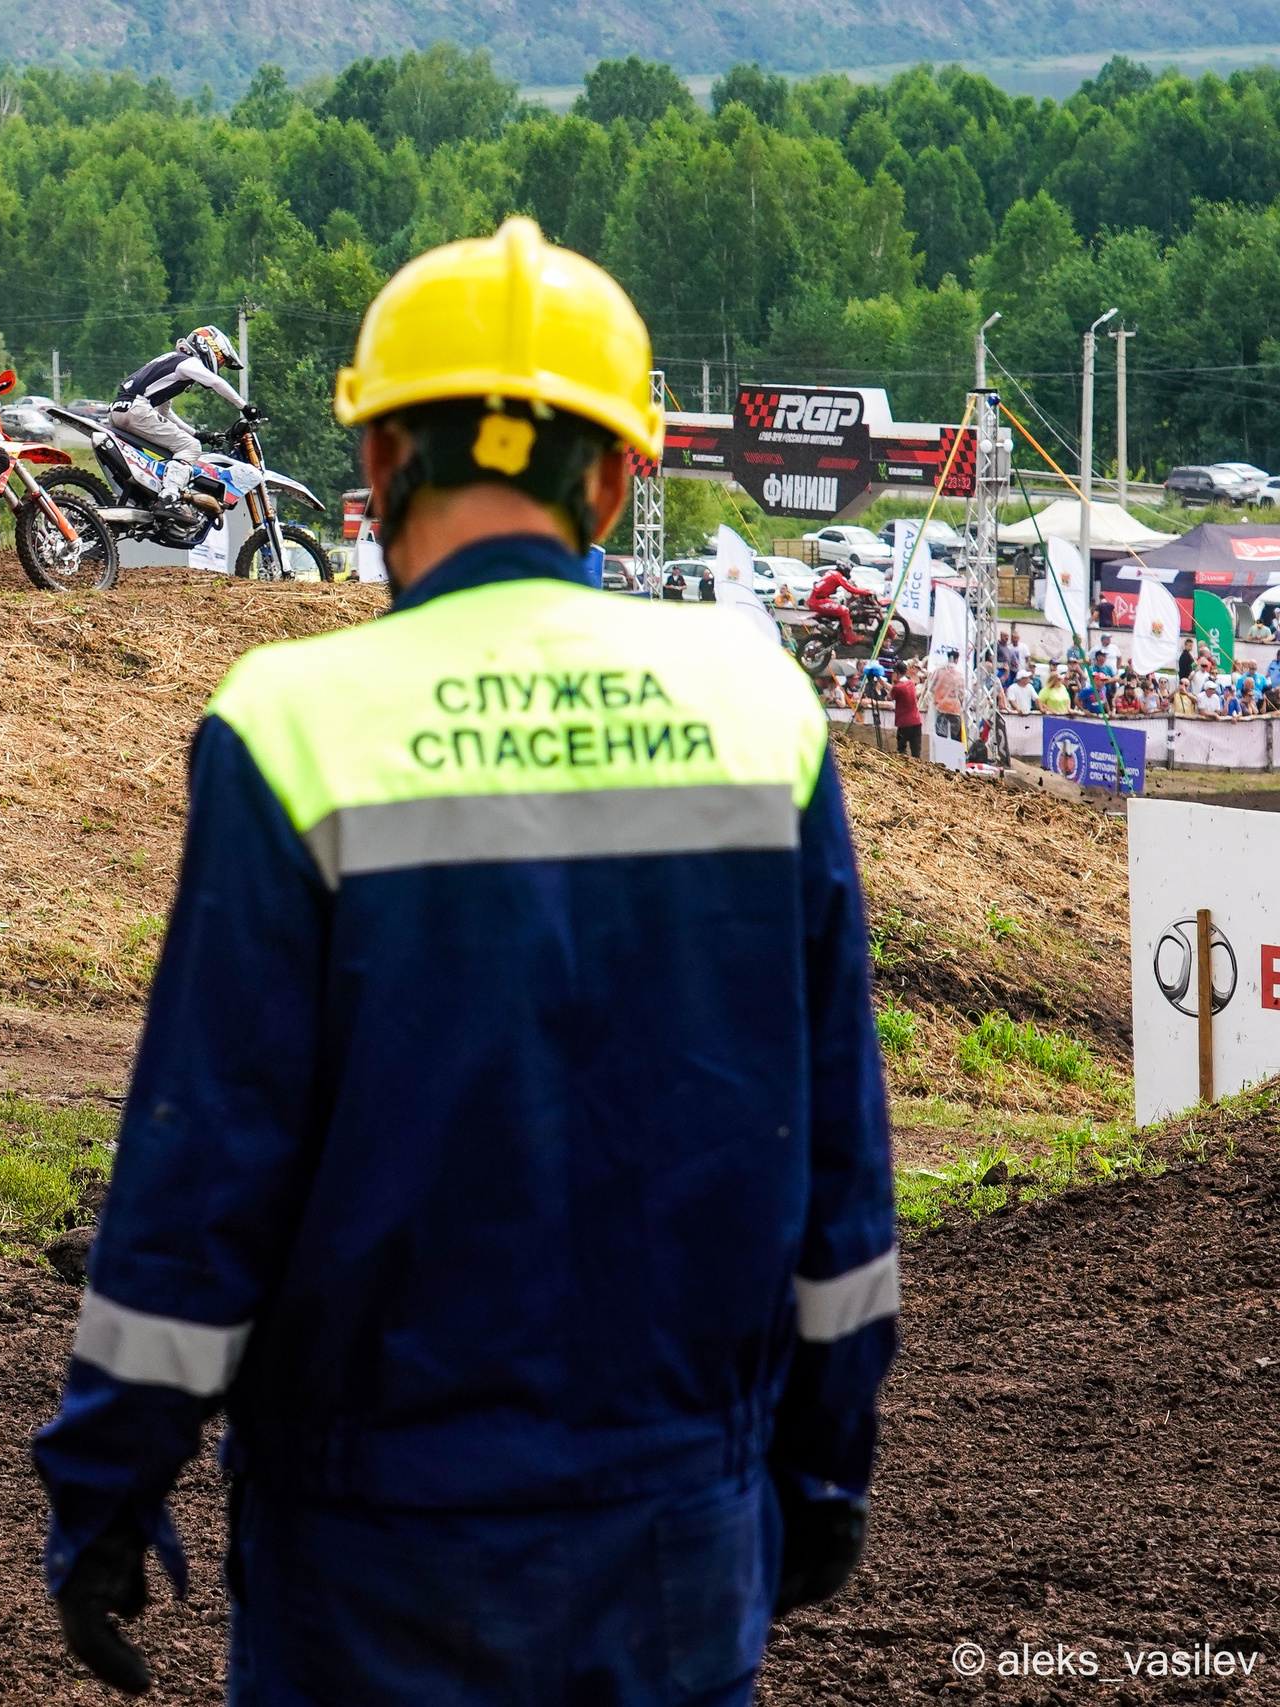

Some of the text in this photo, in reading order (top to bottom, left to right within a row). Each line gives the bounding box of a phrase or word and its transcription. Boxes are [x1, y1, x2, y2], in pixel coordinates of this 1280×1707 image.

[773, 394, 860, 432] RGP
[763, 473, 838, 512] ФИНИШ
[436, 670, 672, 714] СЛУЖБА
[410, 721, 716, 769] СПАСЕНИЯ
